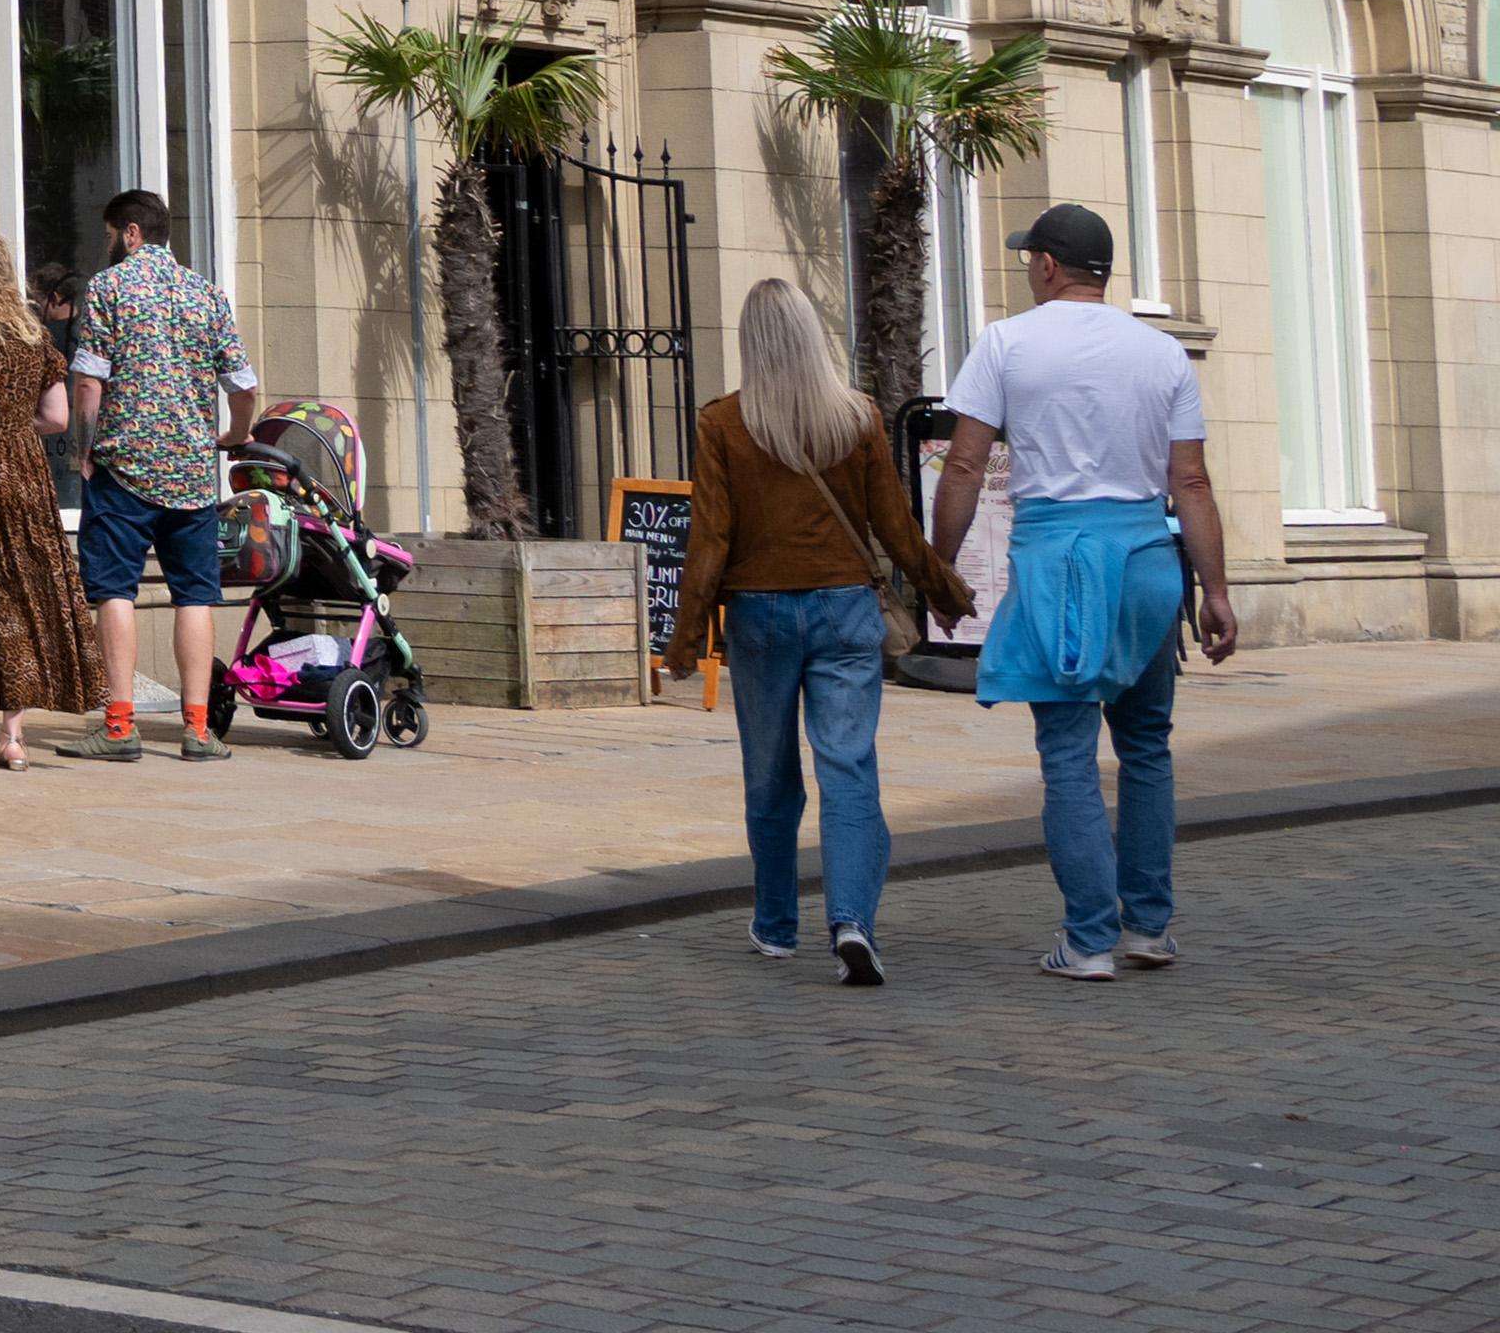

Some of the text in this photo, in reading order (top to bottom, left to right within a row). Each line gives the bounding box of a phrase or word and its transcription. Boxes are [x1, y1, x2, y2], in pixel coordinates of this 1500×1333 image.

[628, 501, 691, 530] 30% OFF
[646, 531, 676, 543] MENU
